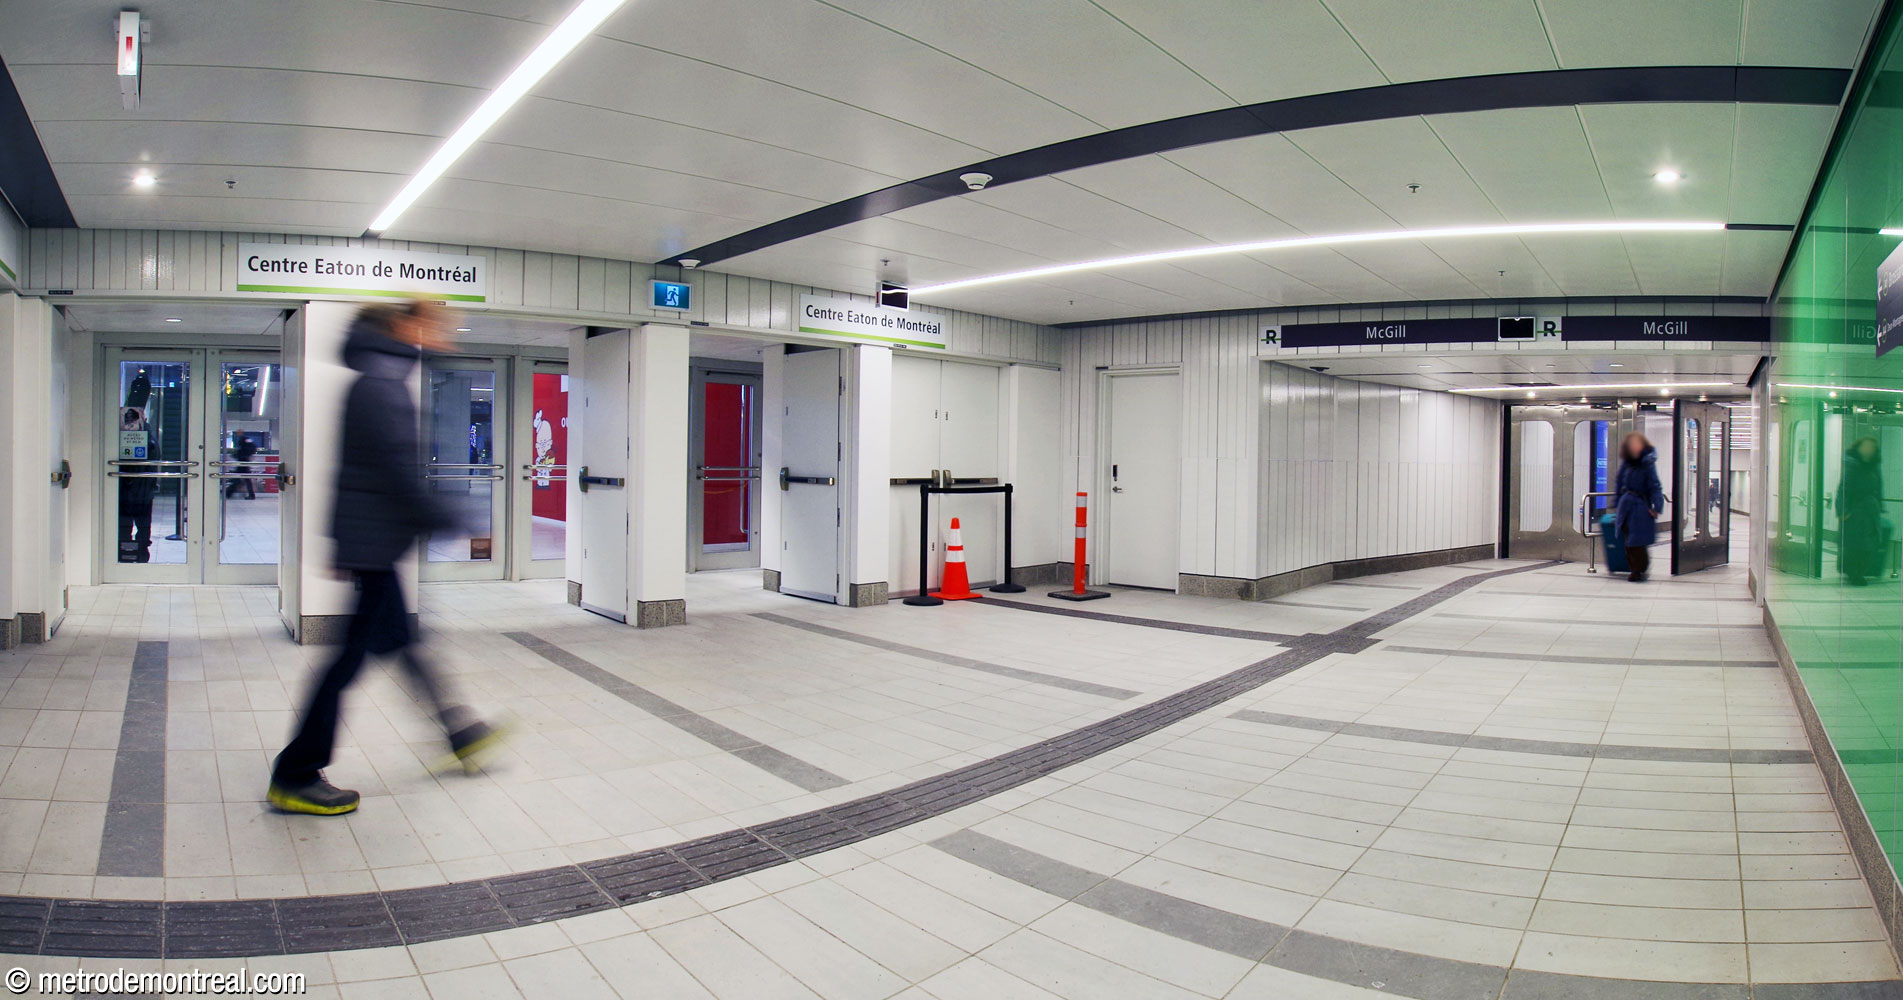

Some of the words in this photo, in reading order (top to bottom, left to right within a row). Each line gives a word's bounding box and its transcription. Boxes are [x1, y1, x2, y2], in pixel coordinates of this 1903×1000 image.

[247, 255, 308, 274] Centre
[315, 258, 366, 276] Eaton
[372, 260, 393, 278] de
[399, 262, 477, 283] Montréal
[806, 304, 844, 322] Centre
[847, 310, 878, 327] Eaton
[881, 314, 894, 328] de
[896, 317, 941, 335] Montréal
[1643, 321, 1688, 335] McGill
[1366, 325, 1406, 339] McGill
